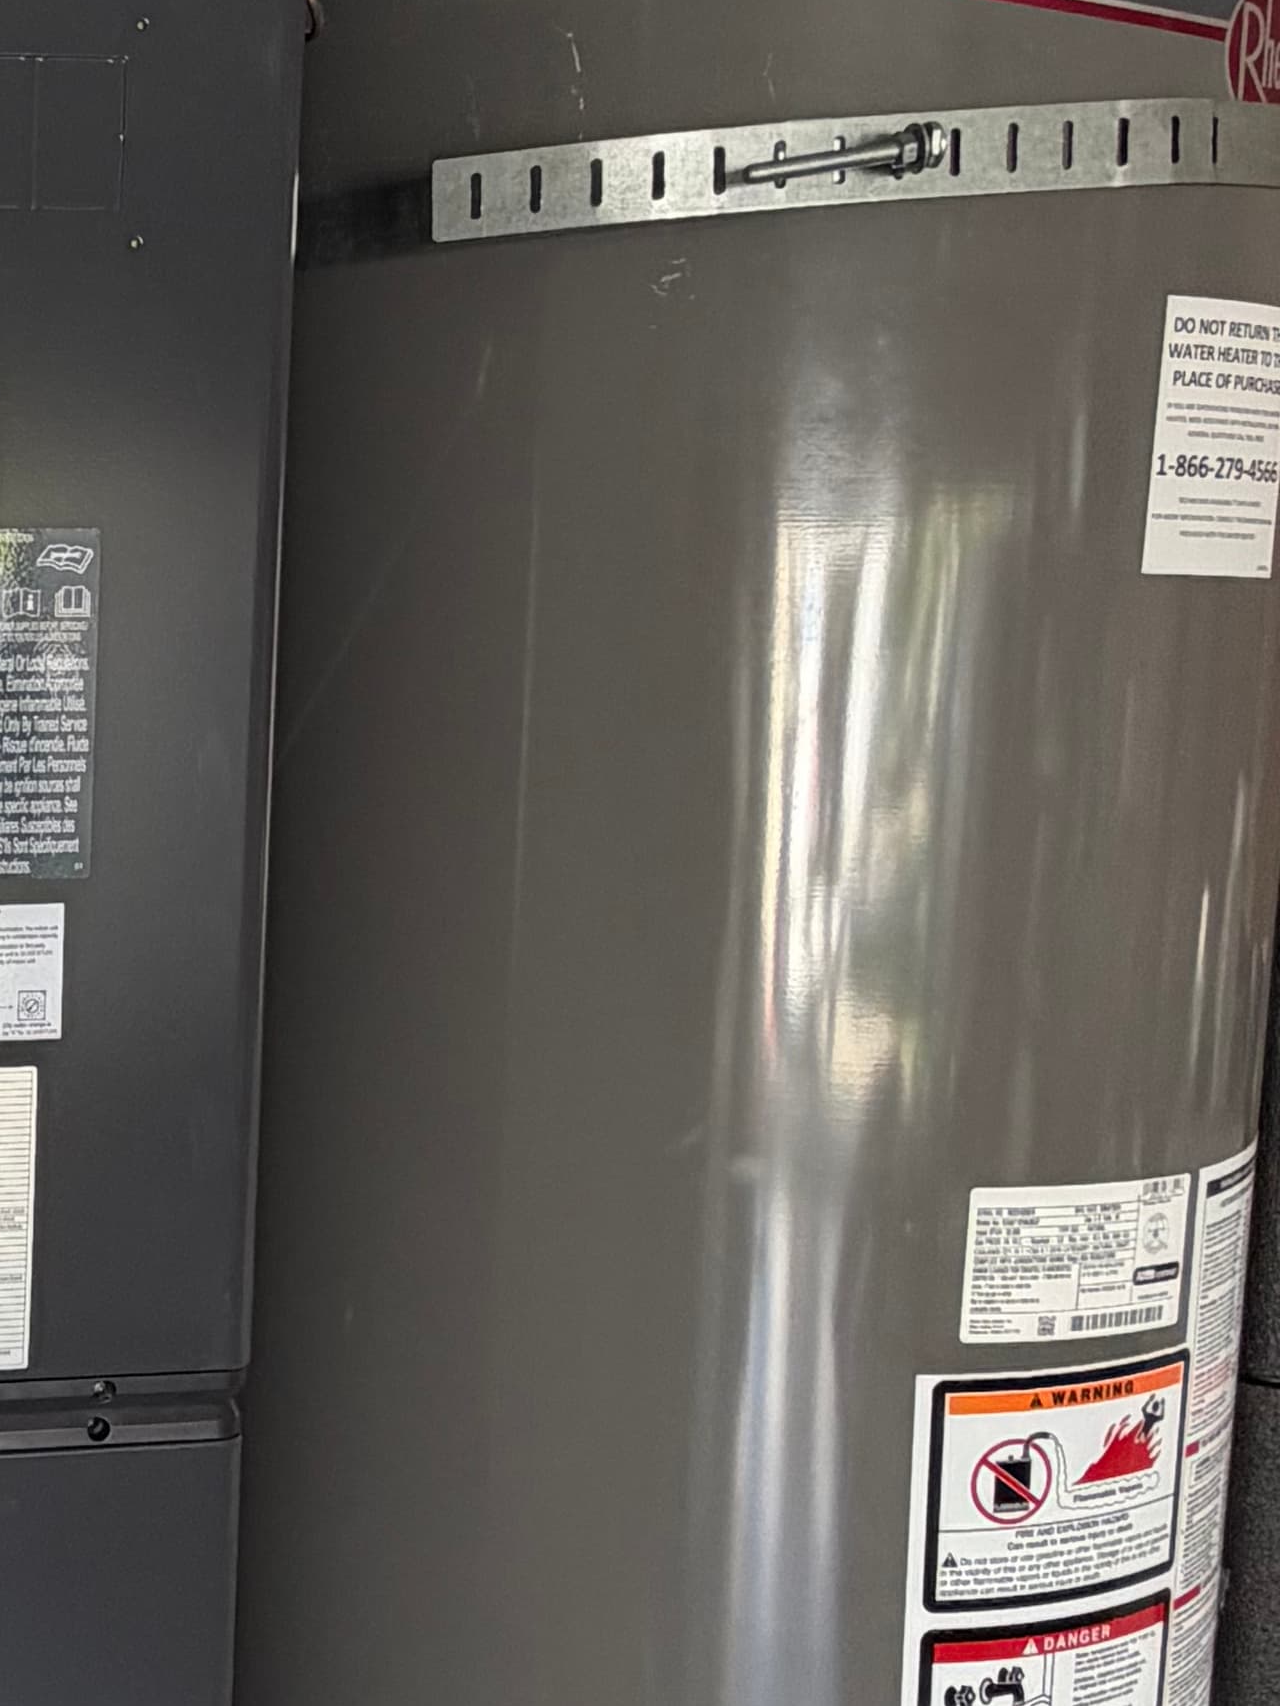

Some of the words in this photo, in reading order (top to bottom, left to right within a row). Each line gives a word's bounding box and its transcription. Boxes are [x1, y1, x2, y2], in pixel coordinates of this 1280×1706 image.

[1174, 317, 1196, 334] DO
[1199, 318, 1227, 336] NOT
[1229, 322, 1270, 341] RETURN
[1168, 343, 1215, 361] WATER
[1217, 347, 1258, 366] HEATER
[1260, 351, 1273, 368] TO
[1173, 370, 1213, 388] PLACE
[1215, 373, 1232, 390] OF
[1156, 454, 1278, 483] 1-866-279-4566
[1052, 1380, 1135, 1405] WARNING
[1015, 1530, 1035, 1539] FIRE
[1036, 1527, 1055, 1536] AND
[1056, 1519, 1100, 1535] EXPLOSION
[1007, 1542, 1023, 1551] Can
[1025, 1539, 1048, 1549] result
[974, 1556, 988, 1565] not
[1043, 1624, 1112, 1652] DANGER
